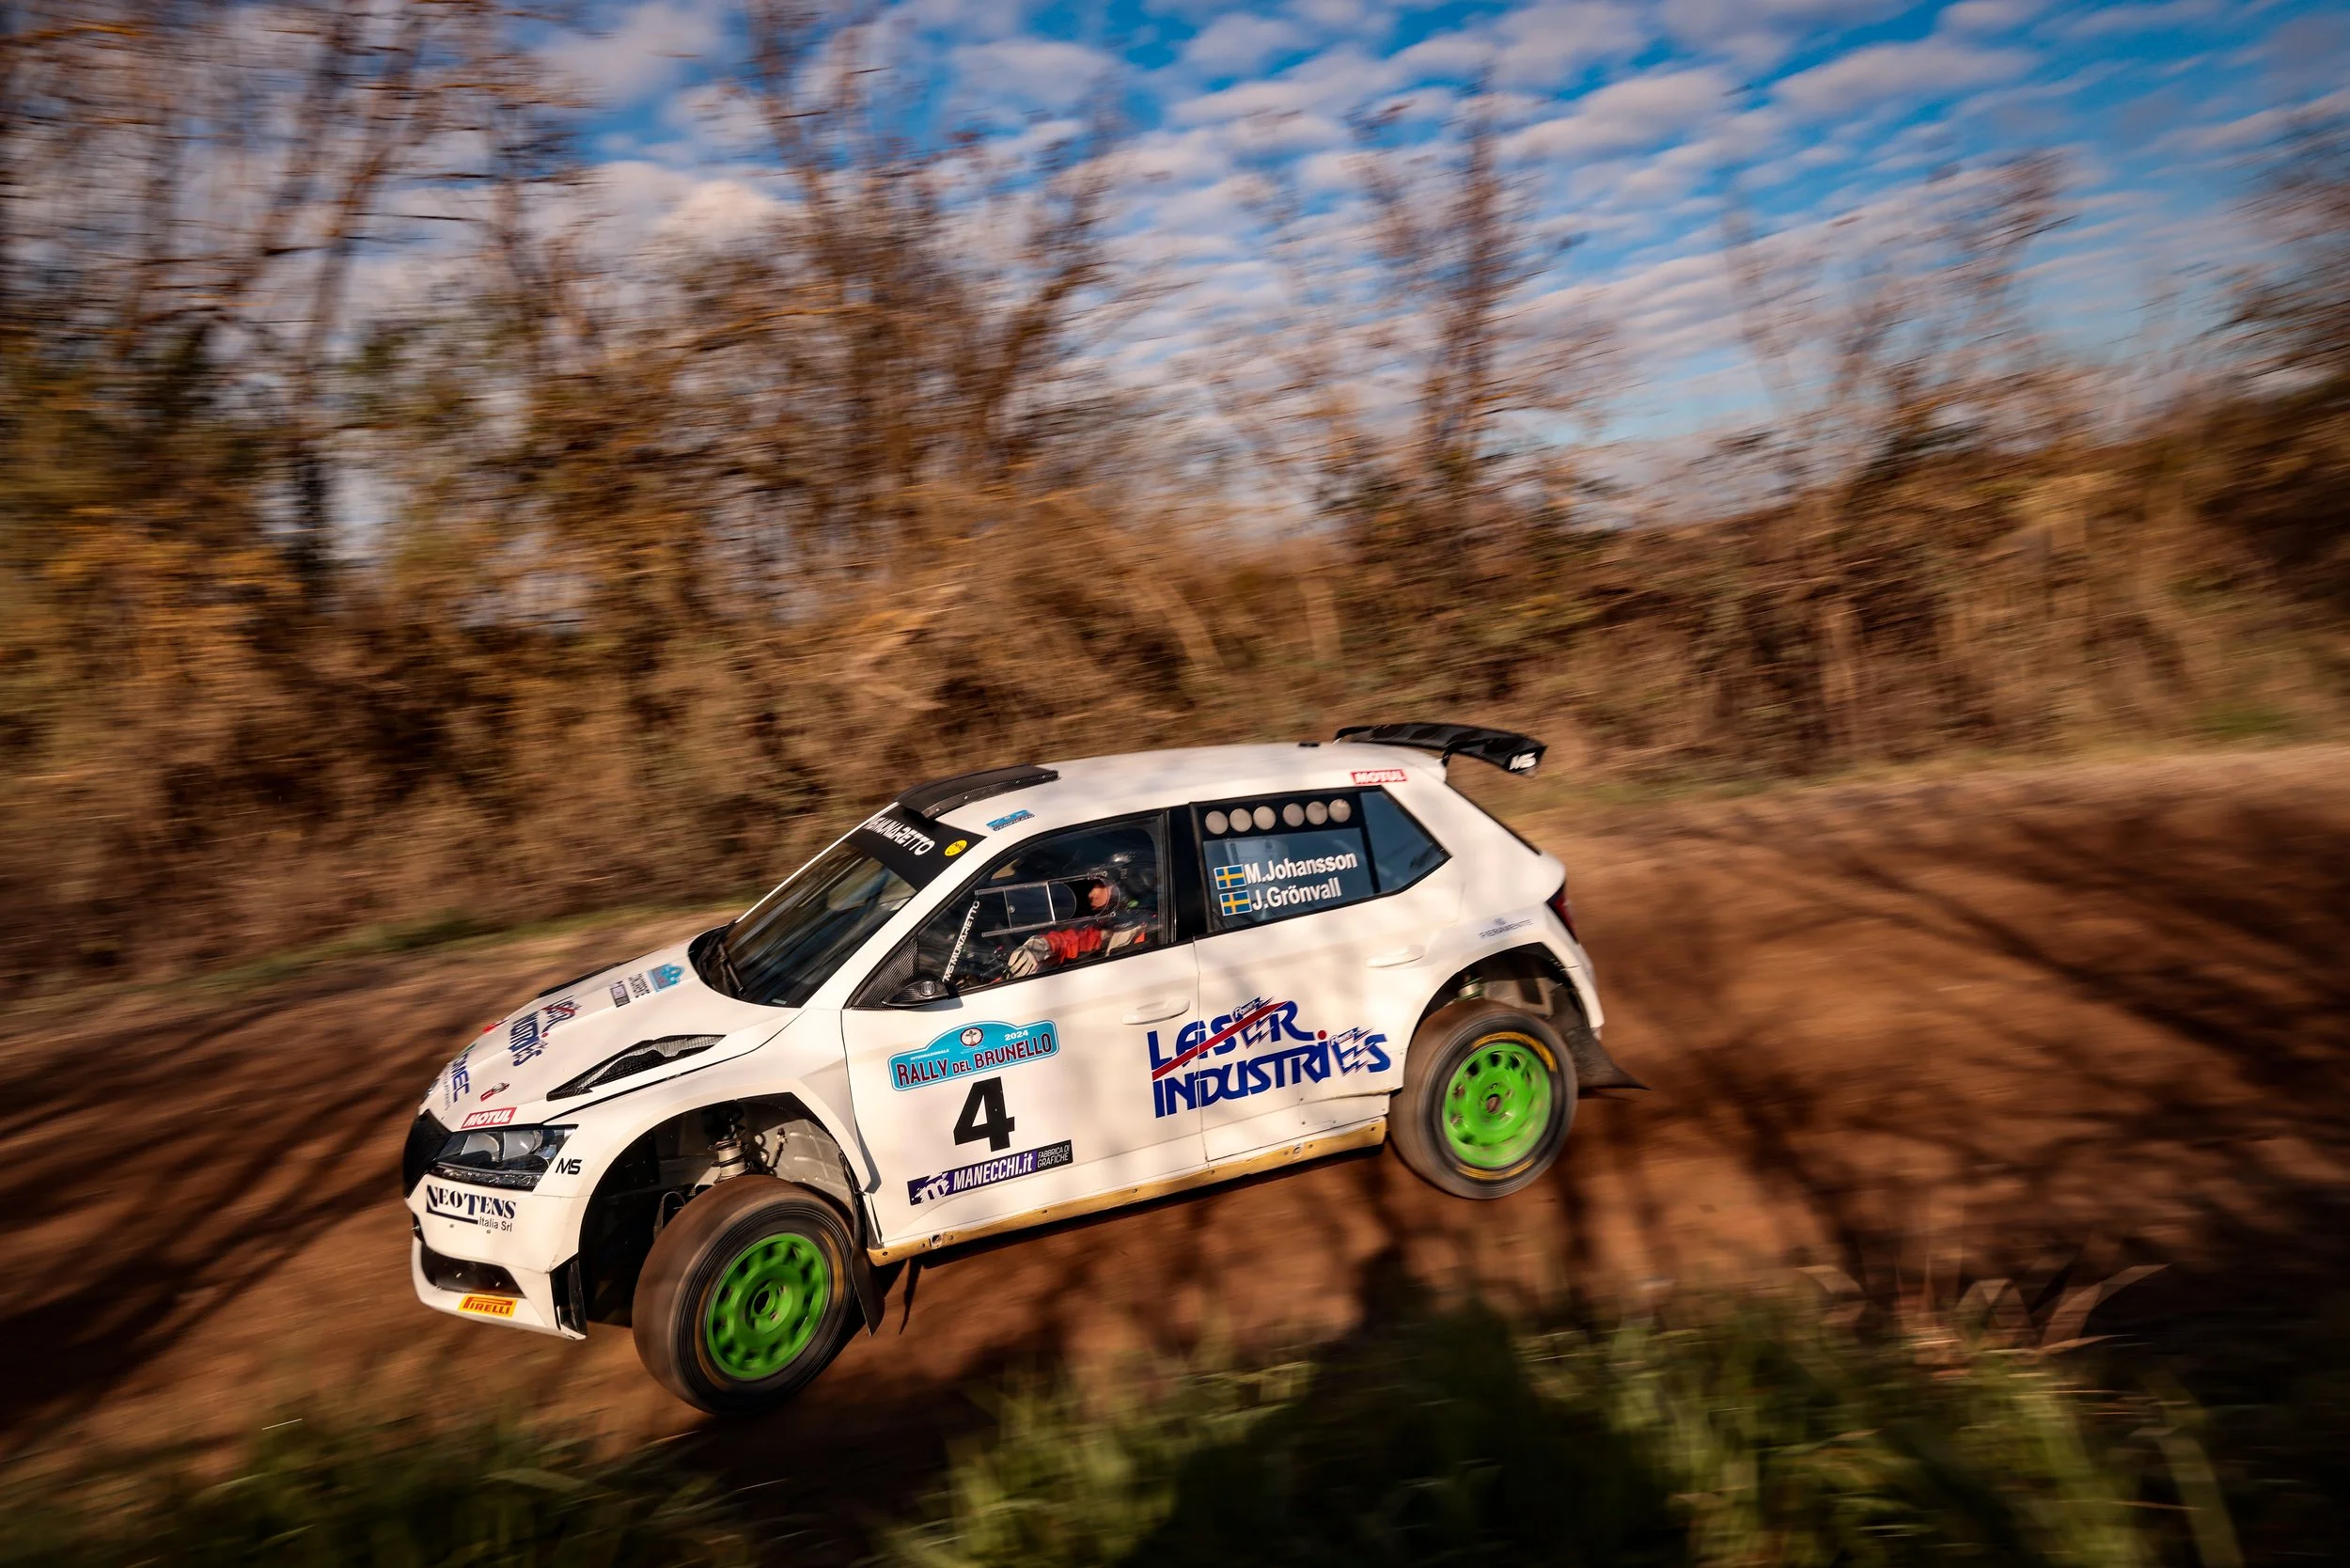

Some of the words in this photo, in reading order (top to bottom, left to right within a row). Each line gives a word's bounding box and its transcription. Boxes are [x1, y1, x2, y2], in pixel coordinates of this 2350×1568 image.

[1355, 770, 1406, 784] MOTUL
[1245, 853, 1358, 885] M.Johansson
[1252, 877, 1342, 911] J.Grönvall
[951, 901, 980, 965] MUNARETTO
[1004, 1030, 1029, 1042] 2024
[1147, 998, 1315, 1077] LASER
[896, 1058, 948, 1087] RALLY
[952, 1060, 972, 1074] DEL
[974, 1033, 1052, 1069] BRUNELLO
[1152, 1028, 1391, 1118] INDUSTRIES
[464, 1108, 514, 1126] MOTUL
[953, 1076, 1015, 1152] 4
[555, 1157, 583, 1175] MS
[1037, 1152, 1070, 1168] GRAFICHE
[1038, 1146, 1064, 1158] FABBRICA
[1063, 1143, 1071, 1153] DI
[952, 1152, 1034, 1191] MANECCHI.it
[426, 1184, 517, 1220] NEOTENS
[478, 1215, 499, 1230] Italia
[501, 1220, 513, 1232] Srl
[462, 1296, 513, 1315] PIRELLI
